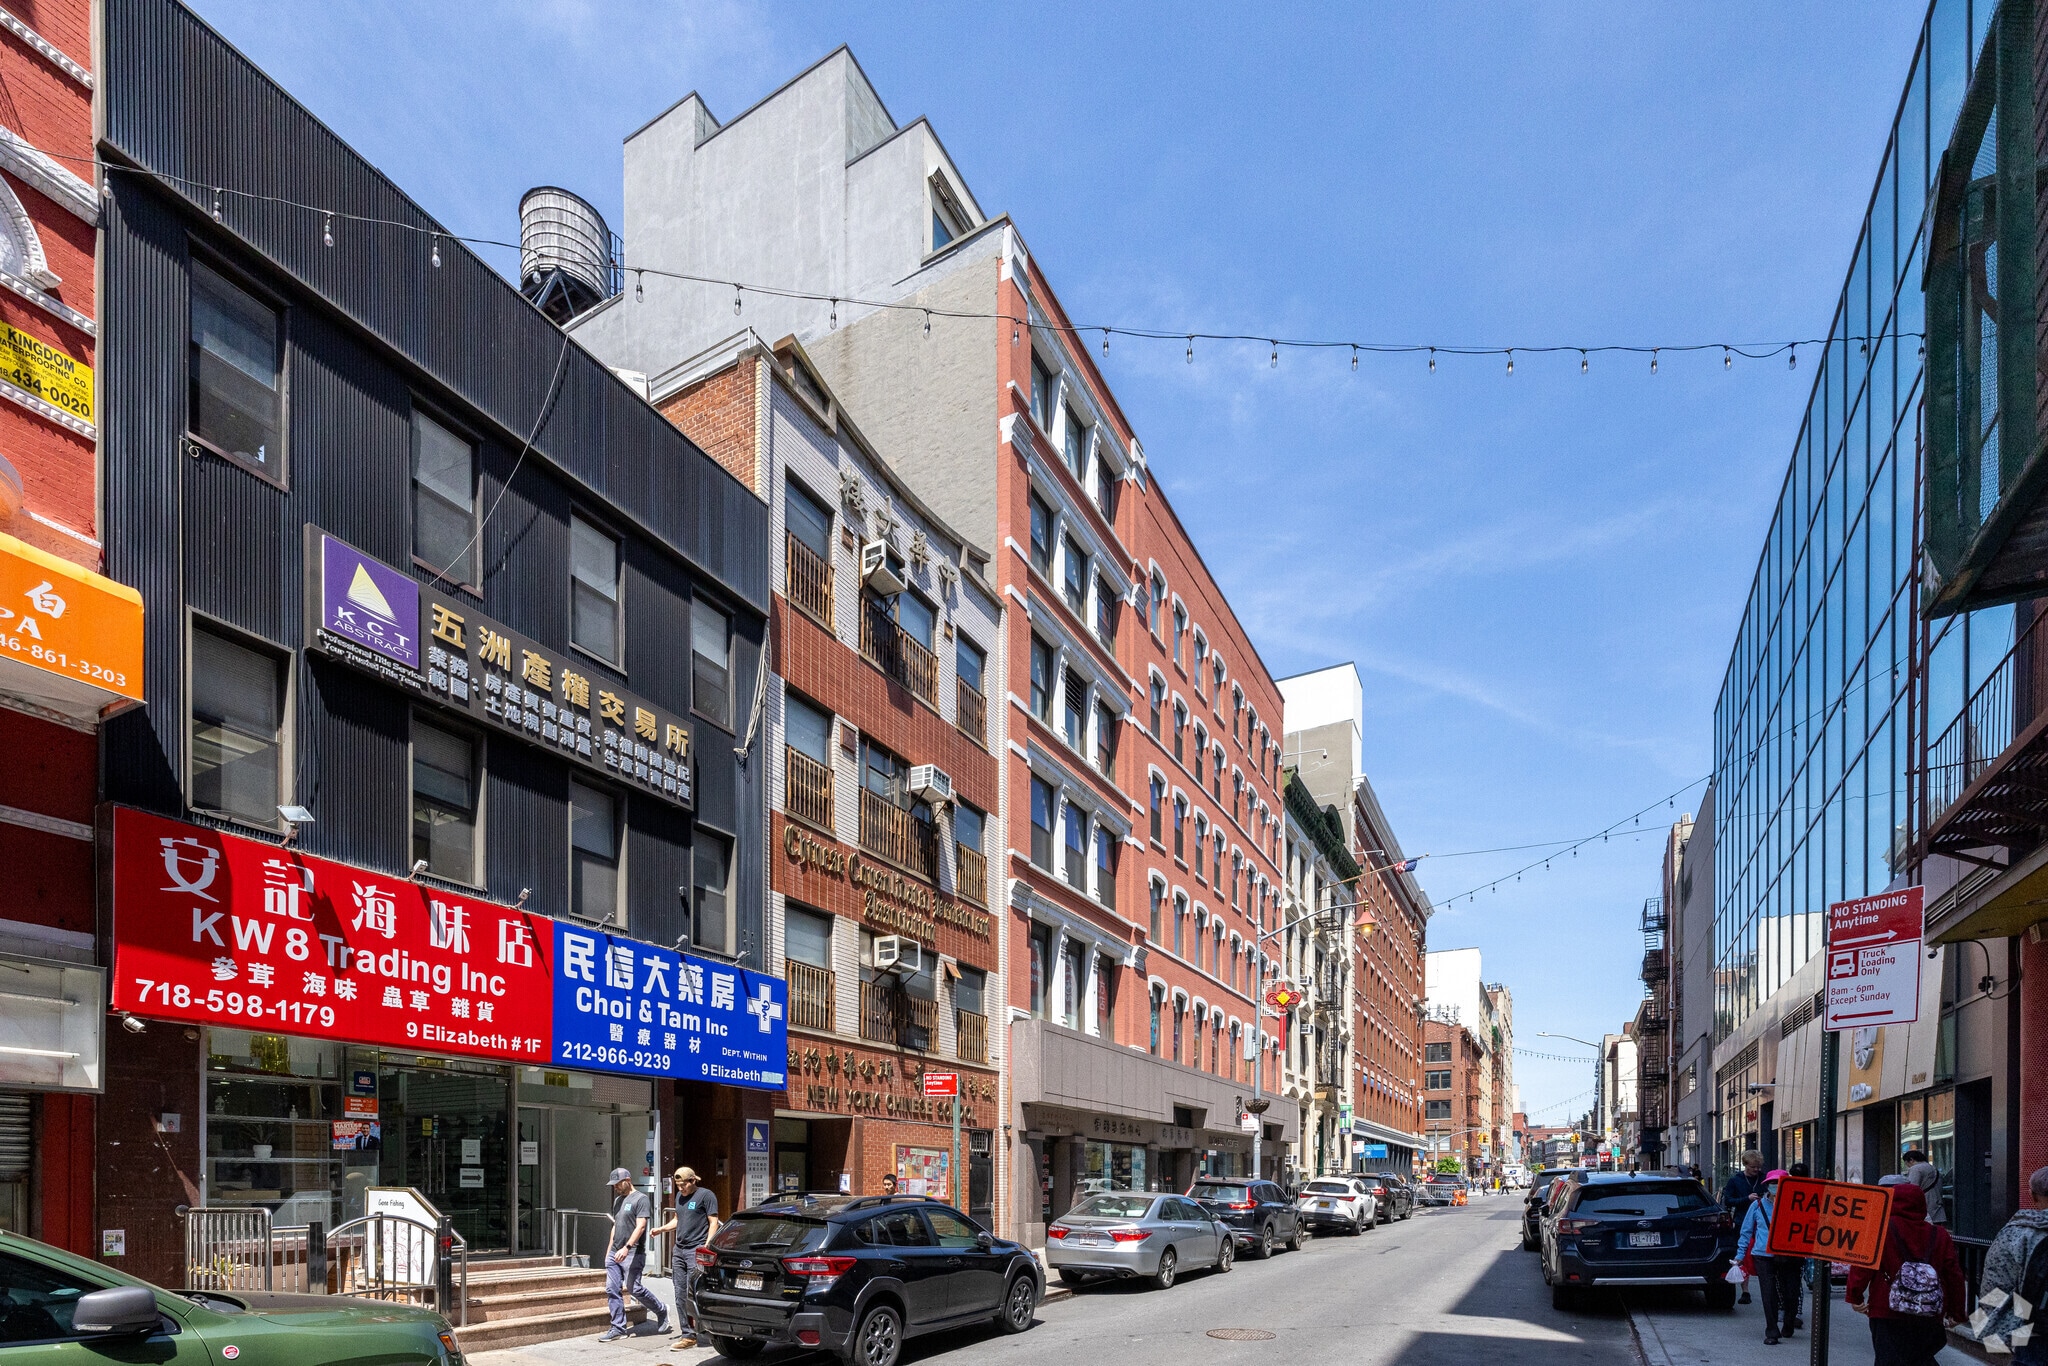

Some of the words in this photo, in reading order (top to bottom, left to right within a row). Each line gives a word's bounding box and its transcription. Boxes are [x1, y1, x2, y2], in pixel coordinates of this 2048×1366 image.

[0, 338, 70, 380] ATERPROOFING
[74, 376, 88, 390] CO.
[8, 328, 75, 374] KINGDOM
[12, 367, 90, 418] 434-0020
[316, 628, 372, 660] Professional
[374, 653, 392, 668] Title
[392, 662, 427, 682] Services
[334, 620, 414, 659] ABSTRACT
[324, 640, 345, 656] Your
[346, 650, 380, 671] Trusted
[380, 666, 398, 680] Title
[399, 674, 421, 689] Team
[431, 602, 689, 757] 五洲產權交易所
[784, 824, 845, 876] Chinese
[848, 852, 931, 912] Consolidated
[864, 890, 936, 942] Association
[1834, 906, 1850, 918] NO
[1852, 894, 1908, 914] STANDING
[1834, 914, 1879, 930] Anytime
[318, 932, 452, 994] Trading
[462, 962, 506, 997] Inc
[1861, 956, 1896, 968] Loading
[1862, 948, 1886, 959] Truck
[564, 931, 735, 1012] 民信大藥房
[1861, 966, 1881, 977] Only
[135, 978, 336, 1028] 718-598-1179
[1830, 995, 1858, 1007] Except
[1860, 991, 1891, 1002] Sunday
[1831, 986, 1848, 996] 8am
[1856, 984, 1875, 995] 6pm
[451, 997, 495, 1023] 雜貨
[576, 986, 632, 1020] Choi
[638, 999, 653, 1023] &
[658, 1001, 701, 1032] Tam
[706, 1017, 729, 1038] Inc
[406, 1022, 418, 1038] 9
[422, 1023, 508, 1050] Elizabeth
[608, 1022, 702, 1054] 醫療器材
[562, 1040, 672, 1071] 212-966-9239
[700, 1062, 710, 1076] 9
[710, 1063, 762, 1083] Elizabeth
[808, 1084, 838, 1104] NEW
[844, 1089, 880, 1108] YORK
[886, 1094, 933, 1114] CHINESE
[936, 1101, 977, 1120] SCOOL
[1790, 1190, 1868, 1220] RAISE
[1788, 1222, 1860, 1251] PLOW
